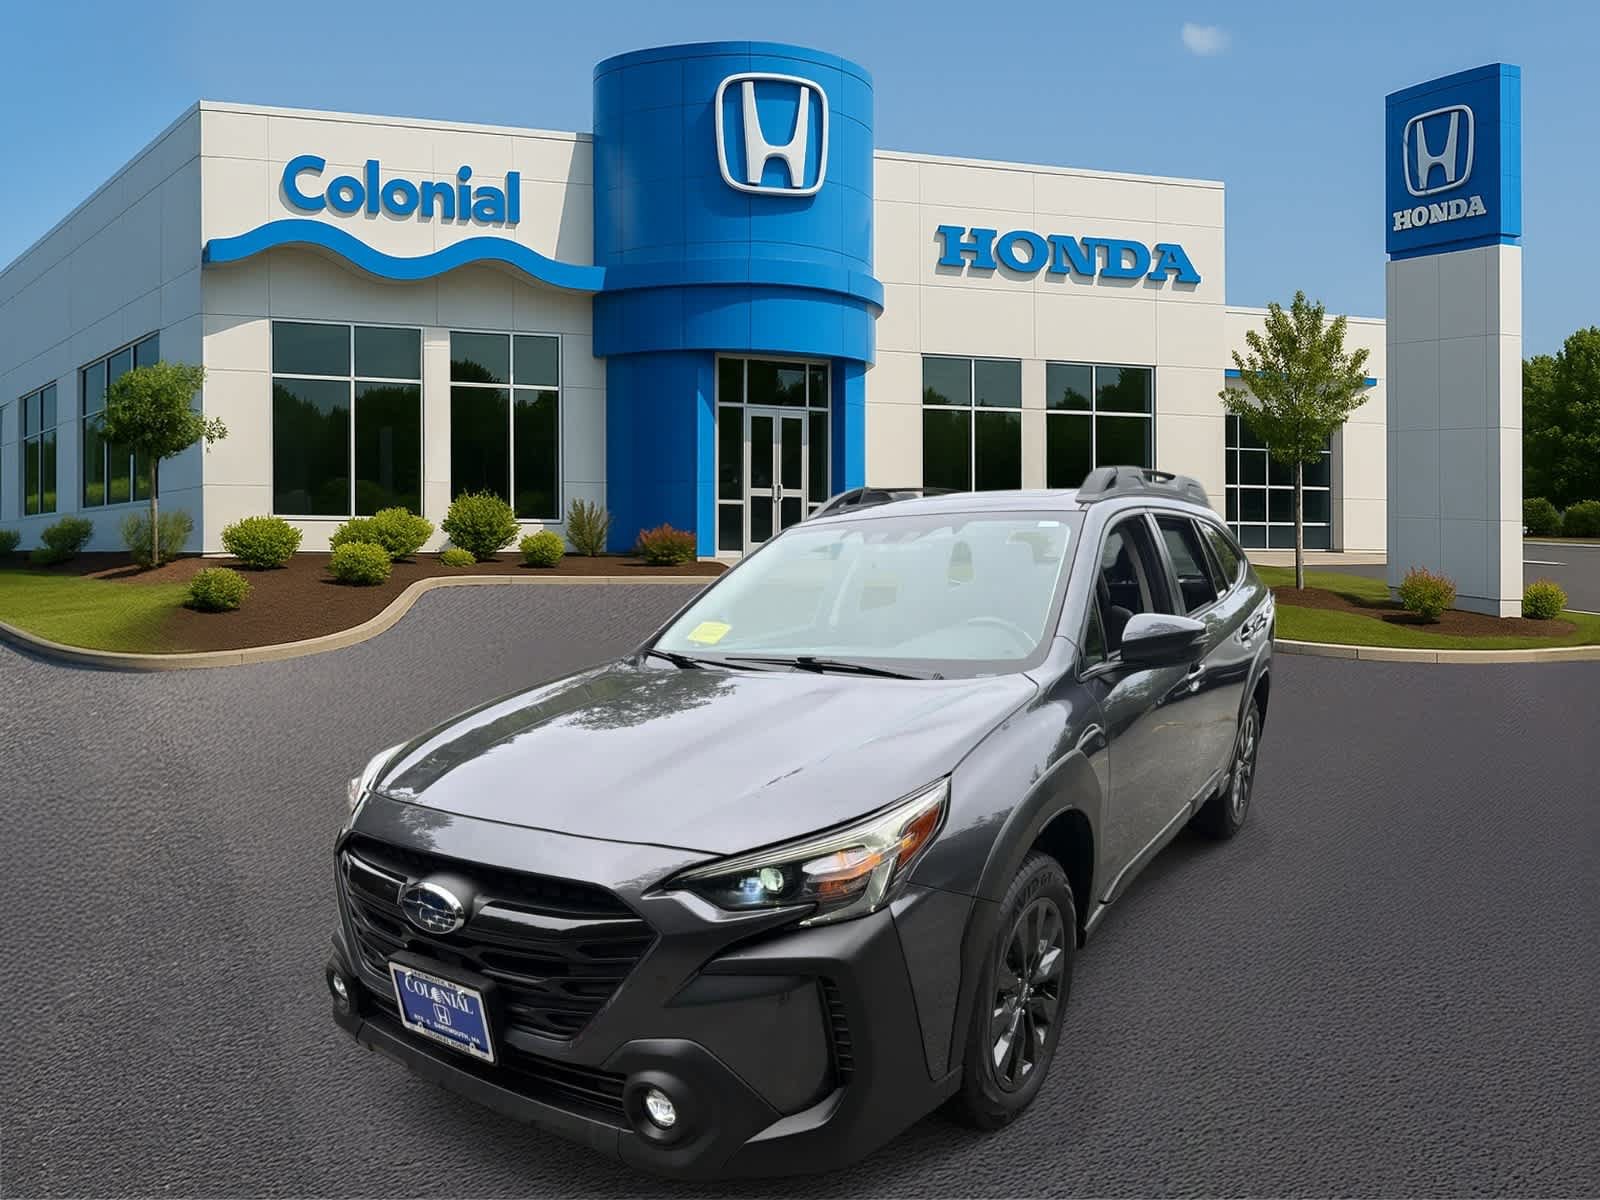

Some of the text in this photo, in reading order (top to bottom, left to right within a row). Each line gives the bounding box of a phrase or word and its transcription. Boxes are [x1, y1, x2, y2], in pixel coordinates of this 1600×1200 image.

[281, 154, 521, 226] Colonial
[1393, 195, 1487, 231] HONDA
[935, 224, 1201, 284] HONDA
[405, 976, 474, 1015] COLONIAL
